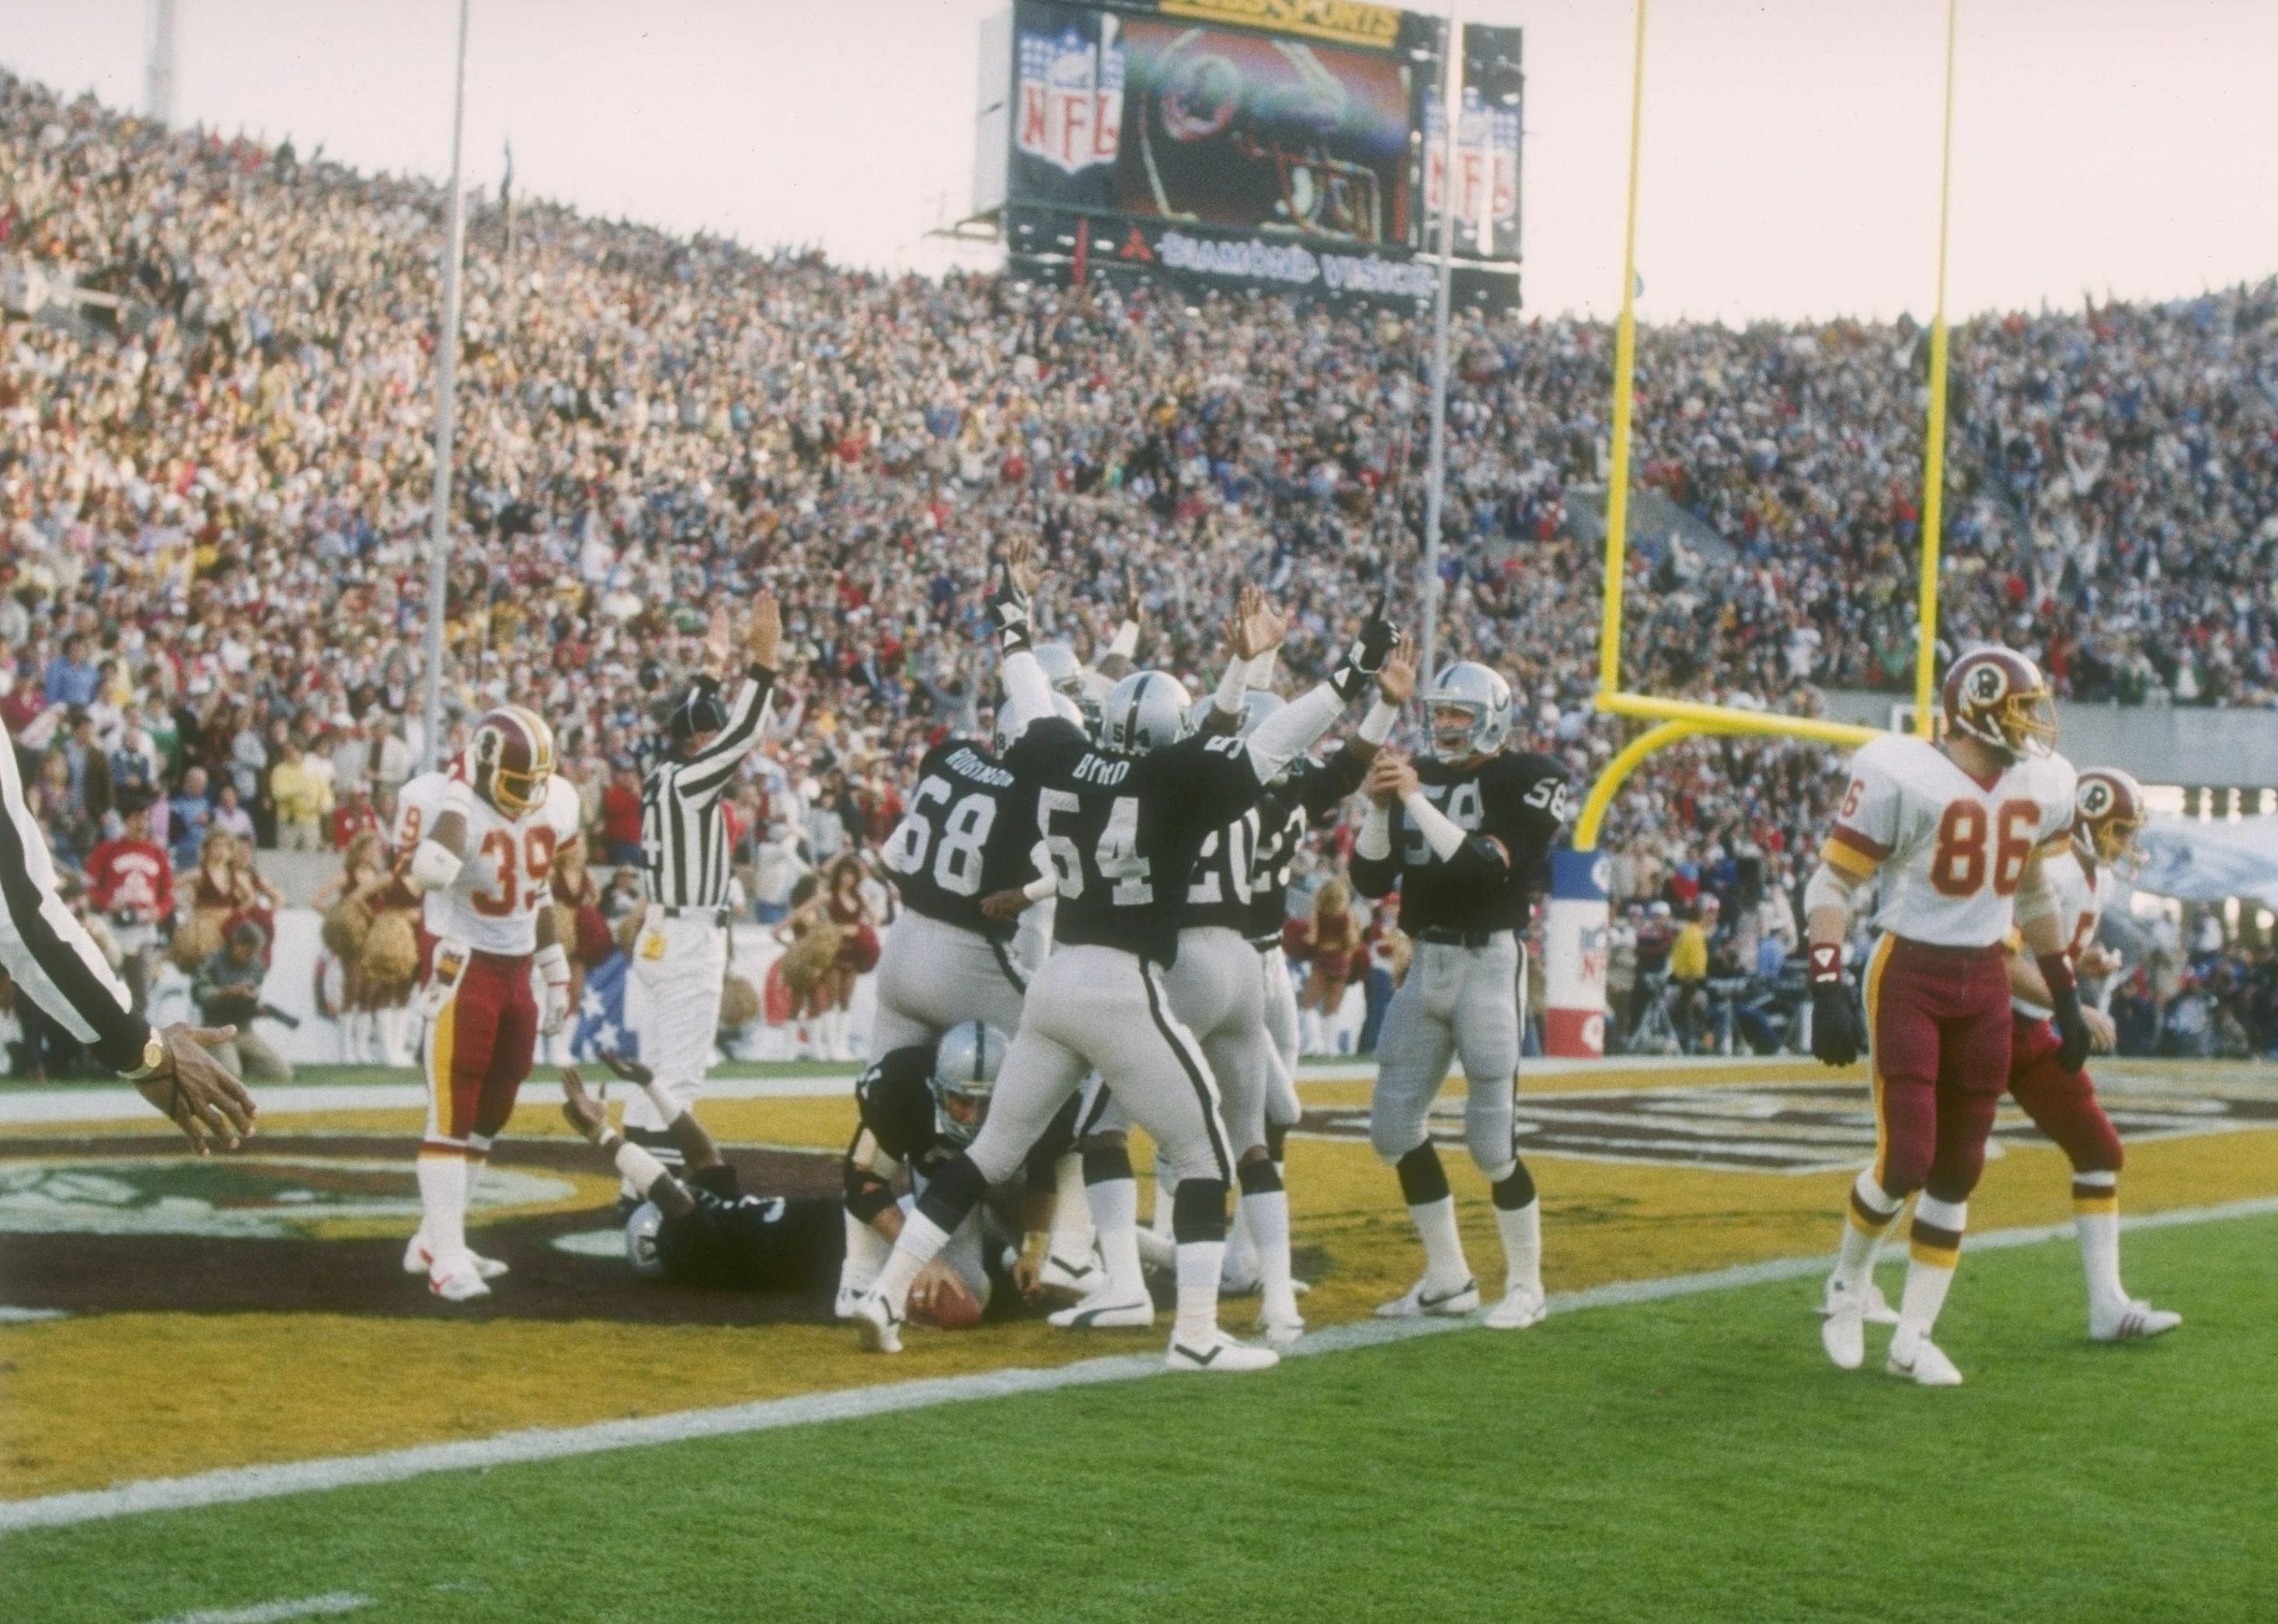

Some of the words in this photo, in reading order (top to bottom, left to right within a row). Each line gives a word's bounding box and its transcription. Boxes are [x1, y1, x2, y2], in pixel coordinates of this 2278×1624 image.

[1023, 84, 1120, 162] NFL
[1112, 723, 1151, 748] 54
[470, 824, 557, 917] 39
[900, 774, 997, 897] 68
[1036, 786, 1155, 906] 54
[1930, 797, 2041, 898] 86
